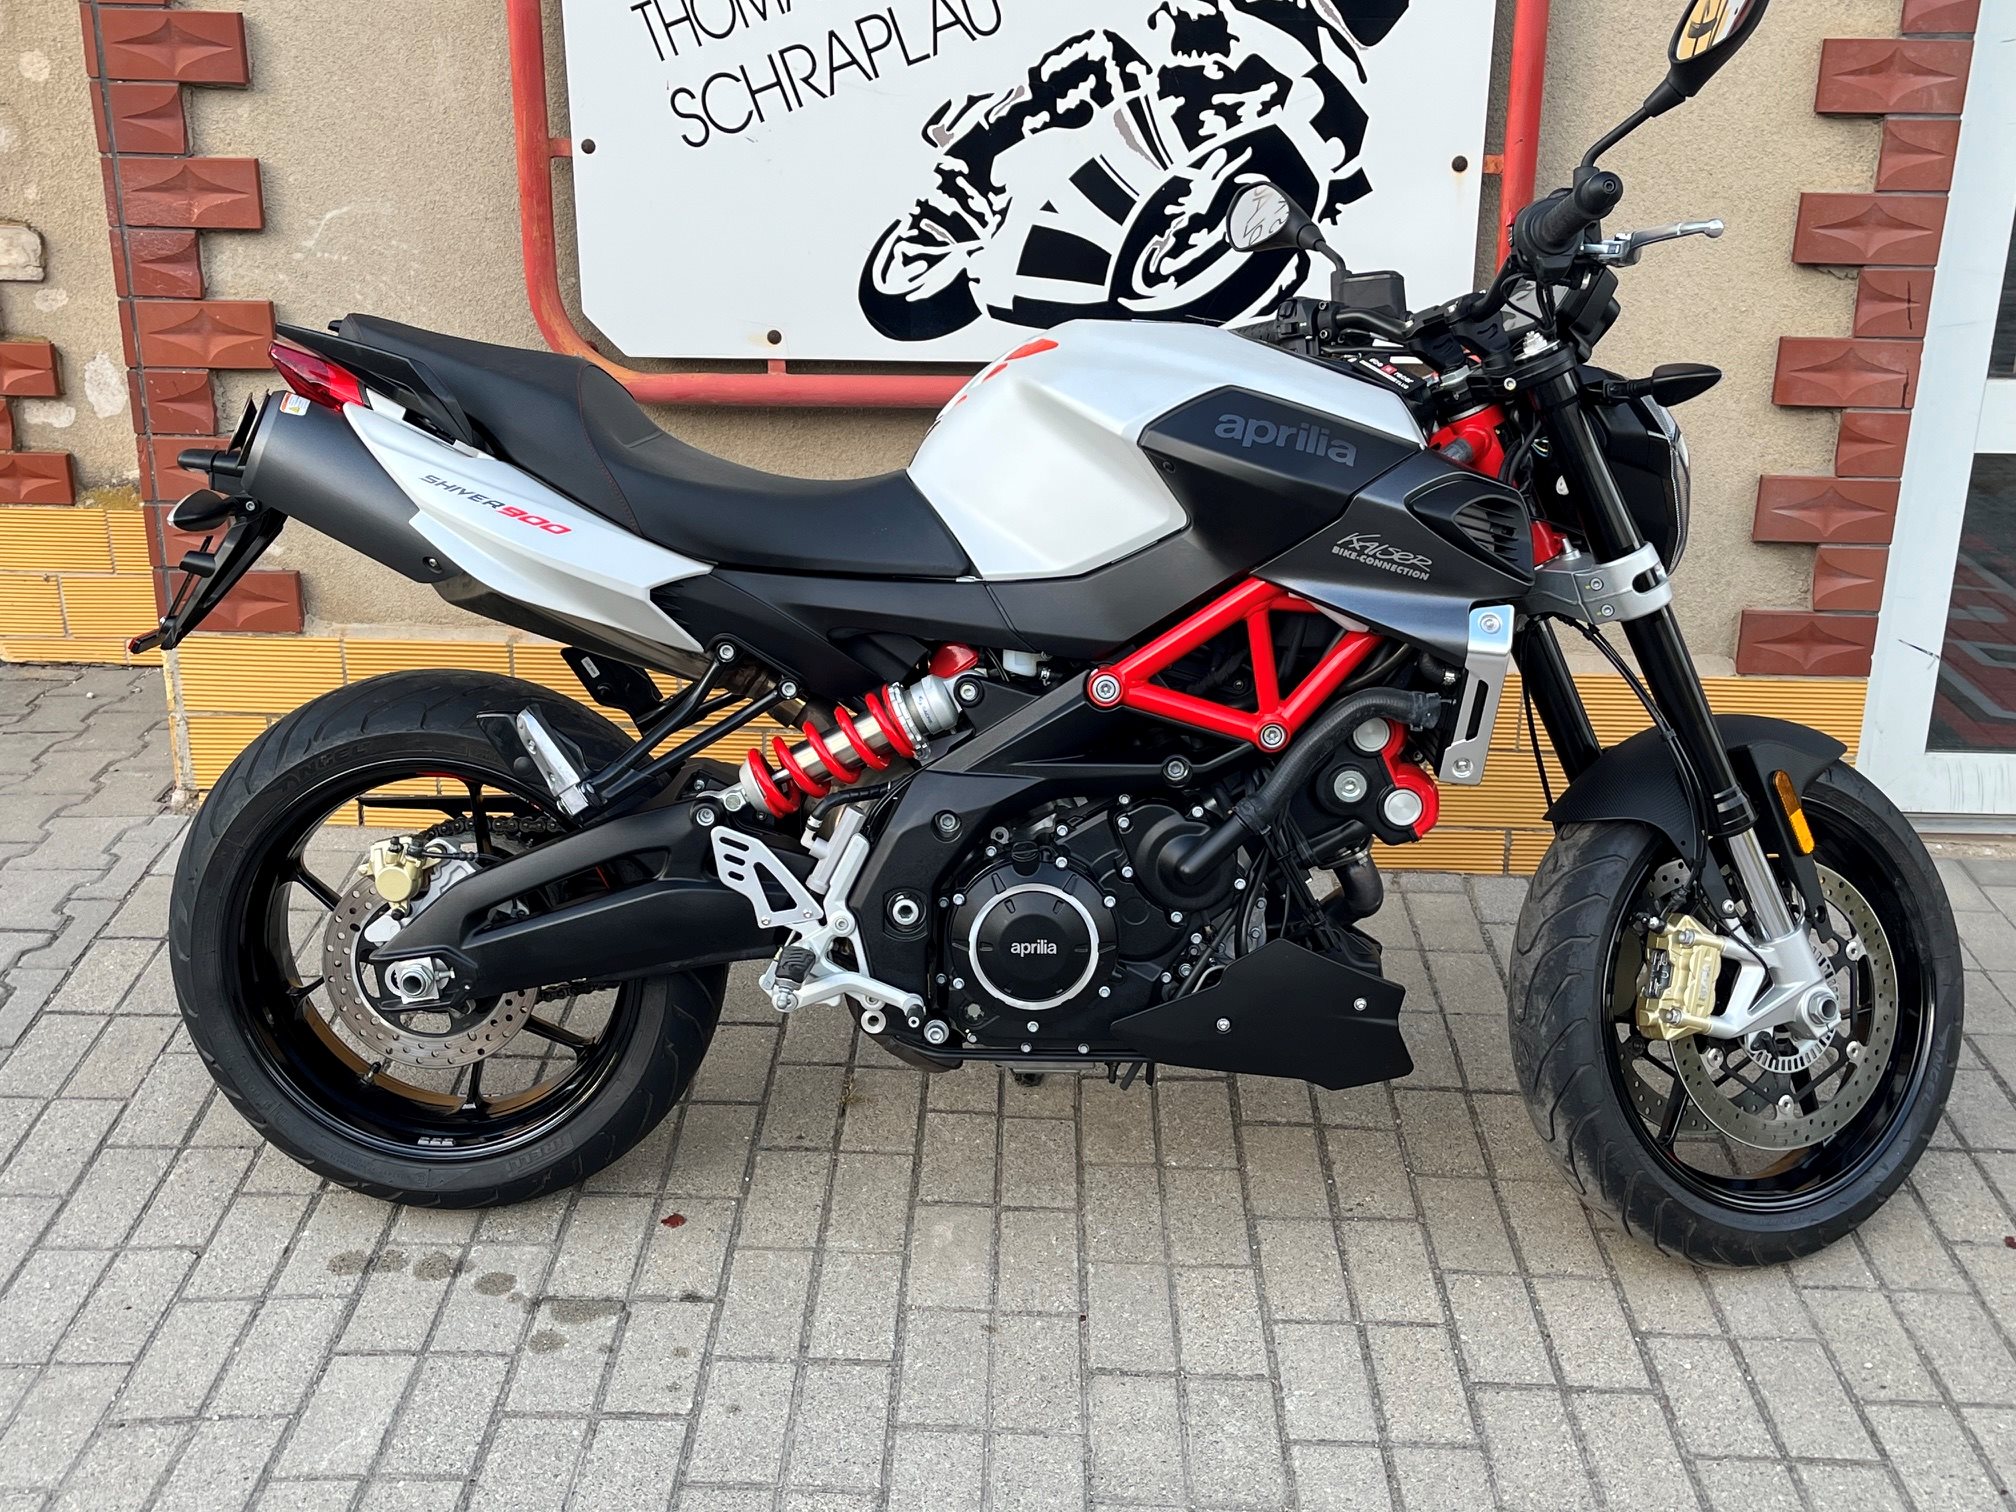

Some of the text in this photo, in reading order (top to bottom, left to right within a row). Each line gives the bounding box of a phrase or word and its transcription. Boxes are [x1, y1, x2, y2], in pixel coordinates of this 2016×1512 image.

[630, 0, 791, 61] THO
[670, 0, 1001, 148] SCHRAPLAU
[1215, 414, 1357, 467] aprilia
[1332, 546, 1430, 581] BIKE-CONNECTION
[1010, 939, 1057, 957] aprilia
